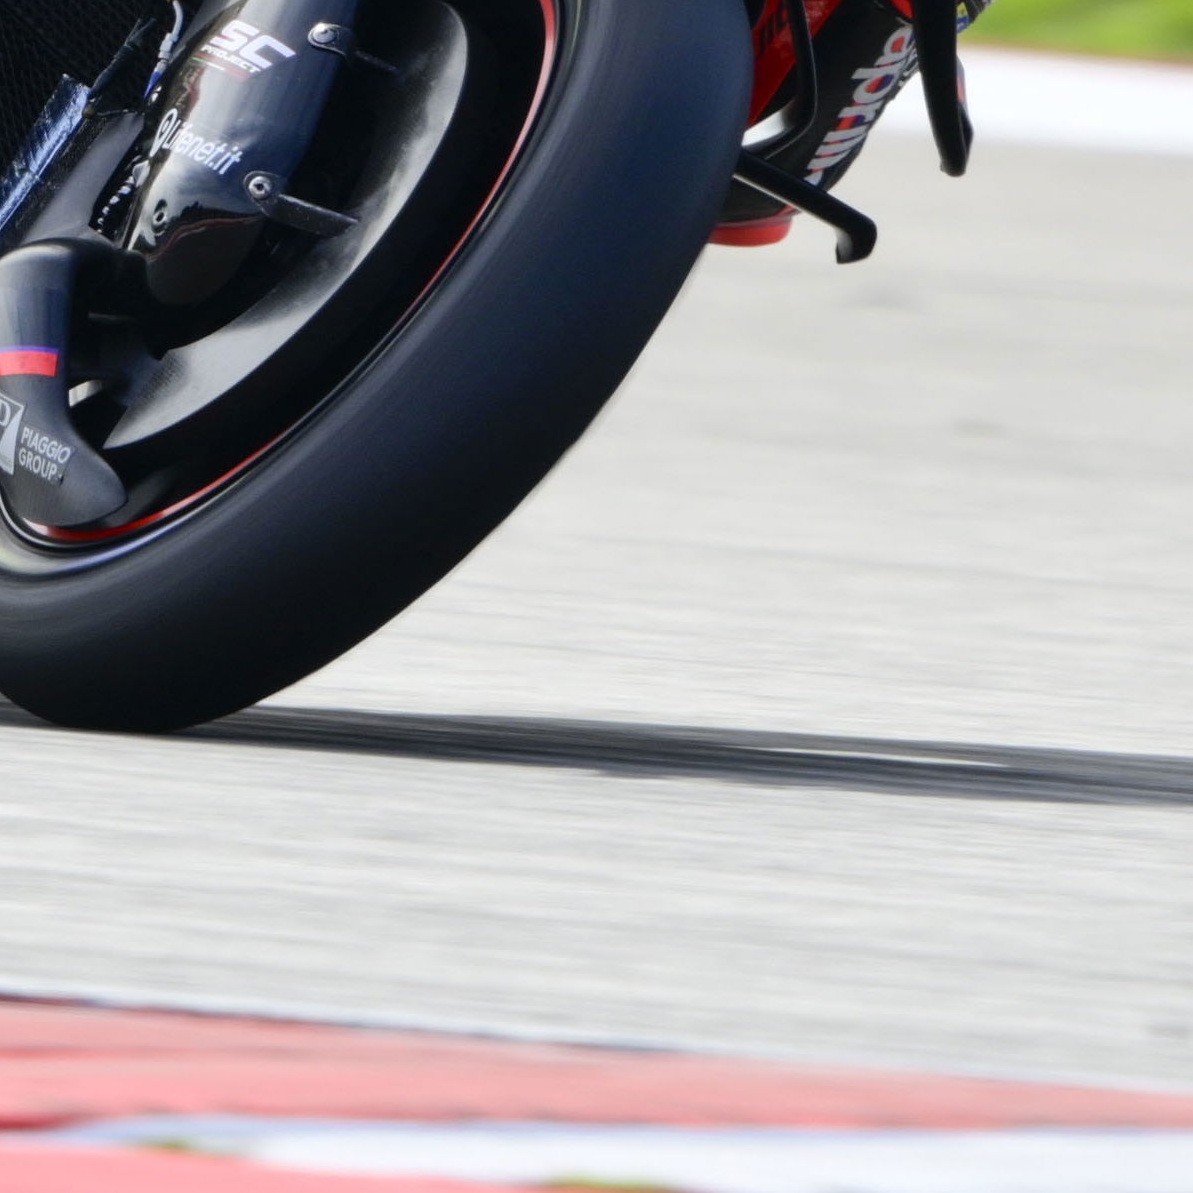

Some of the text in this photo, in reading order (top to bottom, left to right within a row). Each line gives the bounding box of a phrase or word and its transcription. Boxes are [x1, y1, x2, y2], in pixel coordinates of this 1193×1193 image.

[200, 44, 262, 74] PROJECT
[209, 20, 297, 70] SC
[20, 426, 71, 464] PIAGGIO
[18, 447, 58, 481] GROUP
